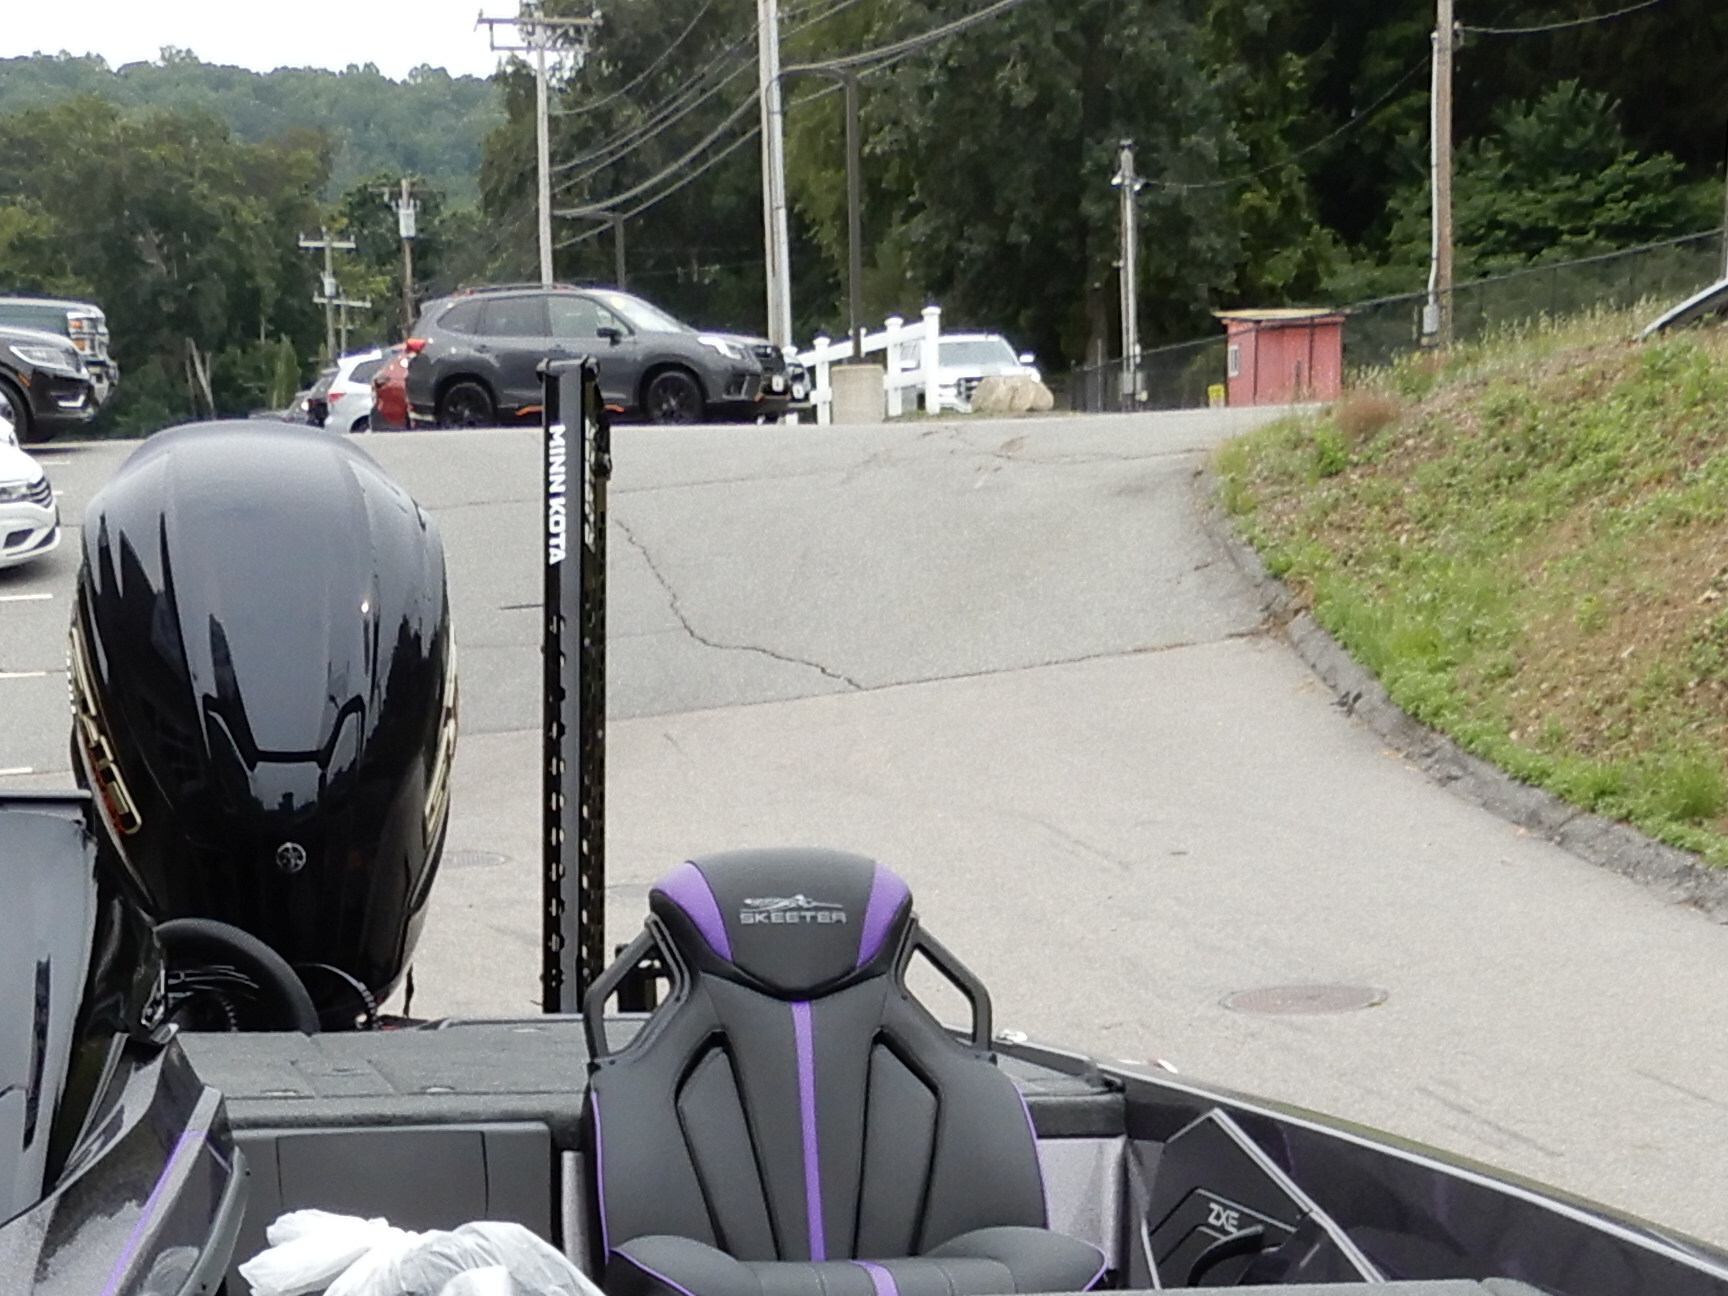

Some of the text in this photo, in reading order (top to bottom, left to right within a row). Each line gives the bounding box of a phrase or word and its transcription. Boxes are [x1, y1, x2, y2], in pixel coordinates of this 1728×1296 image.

[548, 424, 567, 566] MINN KOTA
[739, 911, 847, 924] SKEETER
